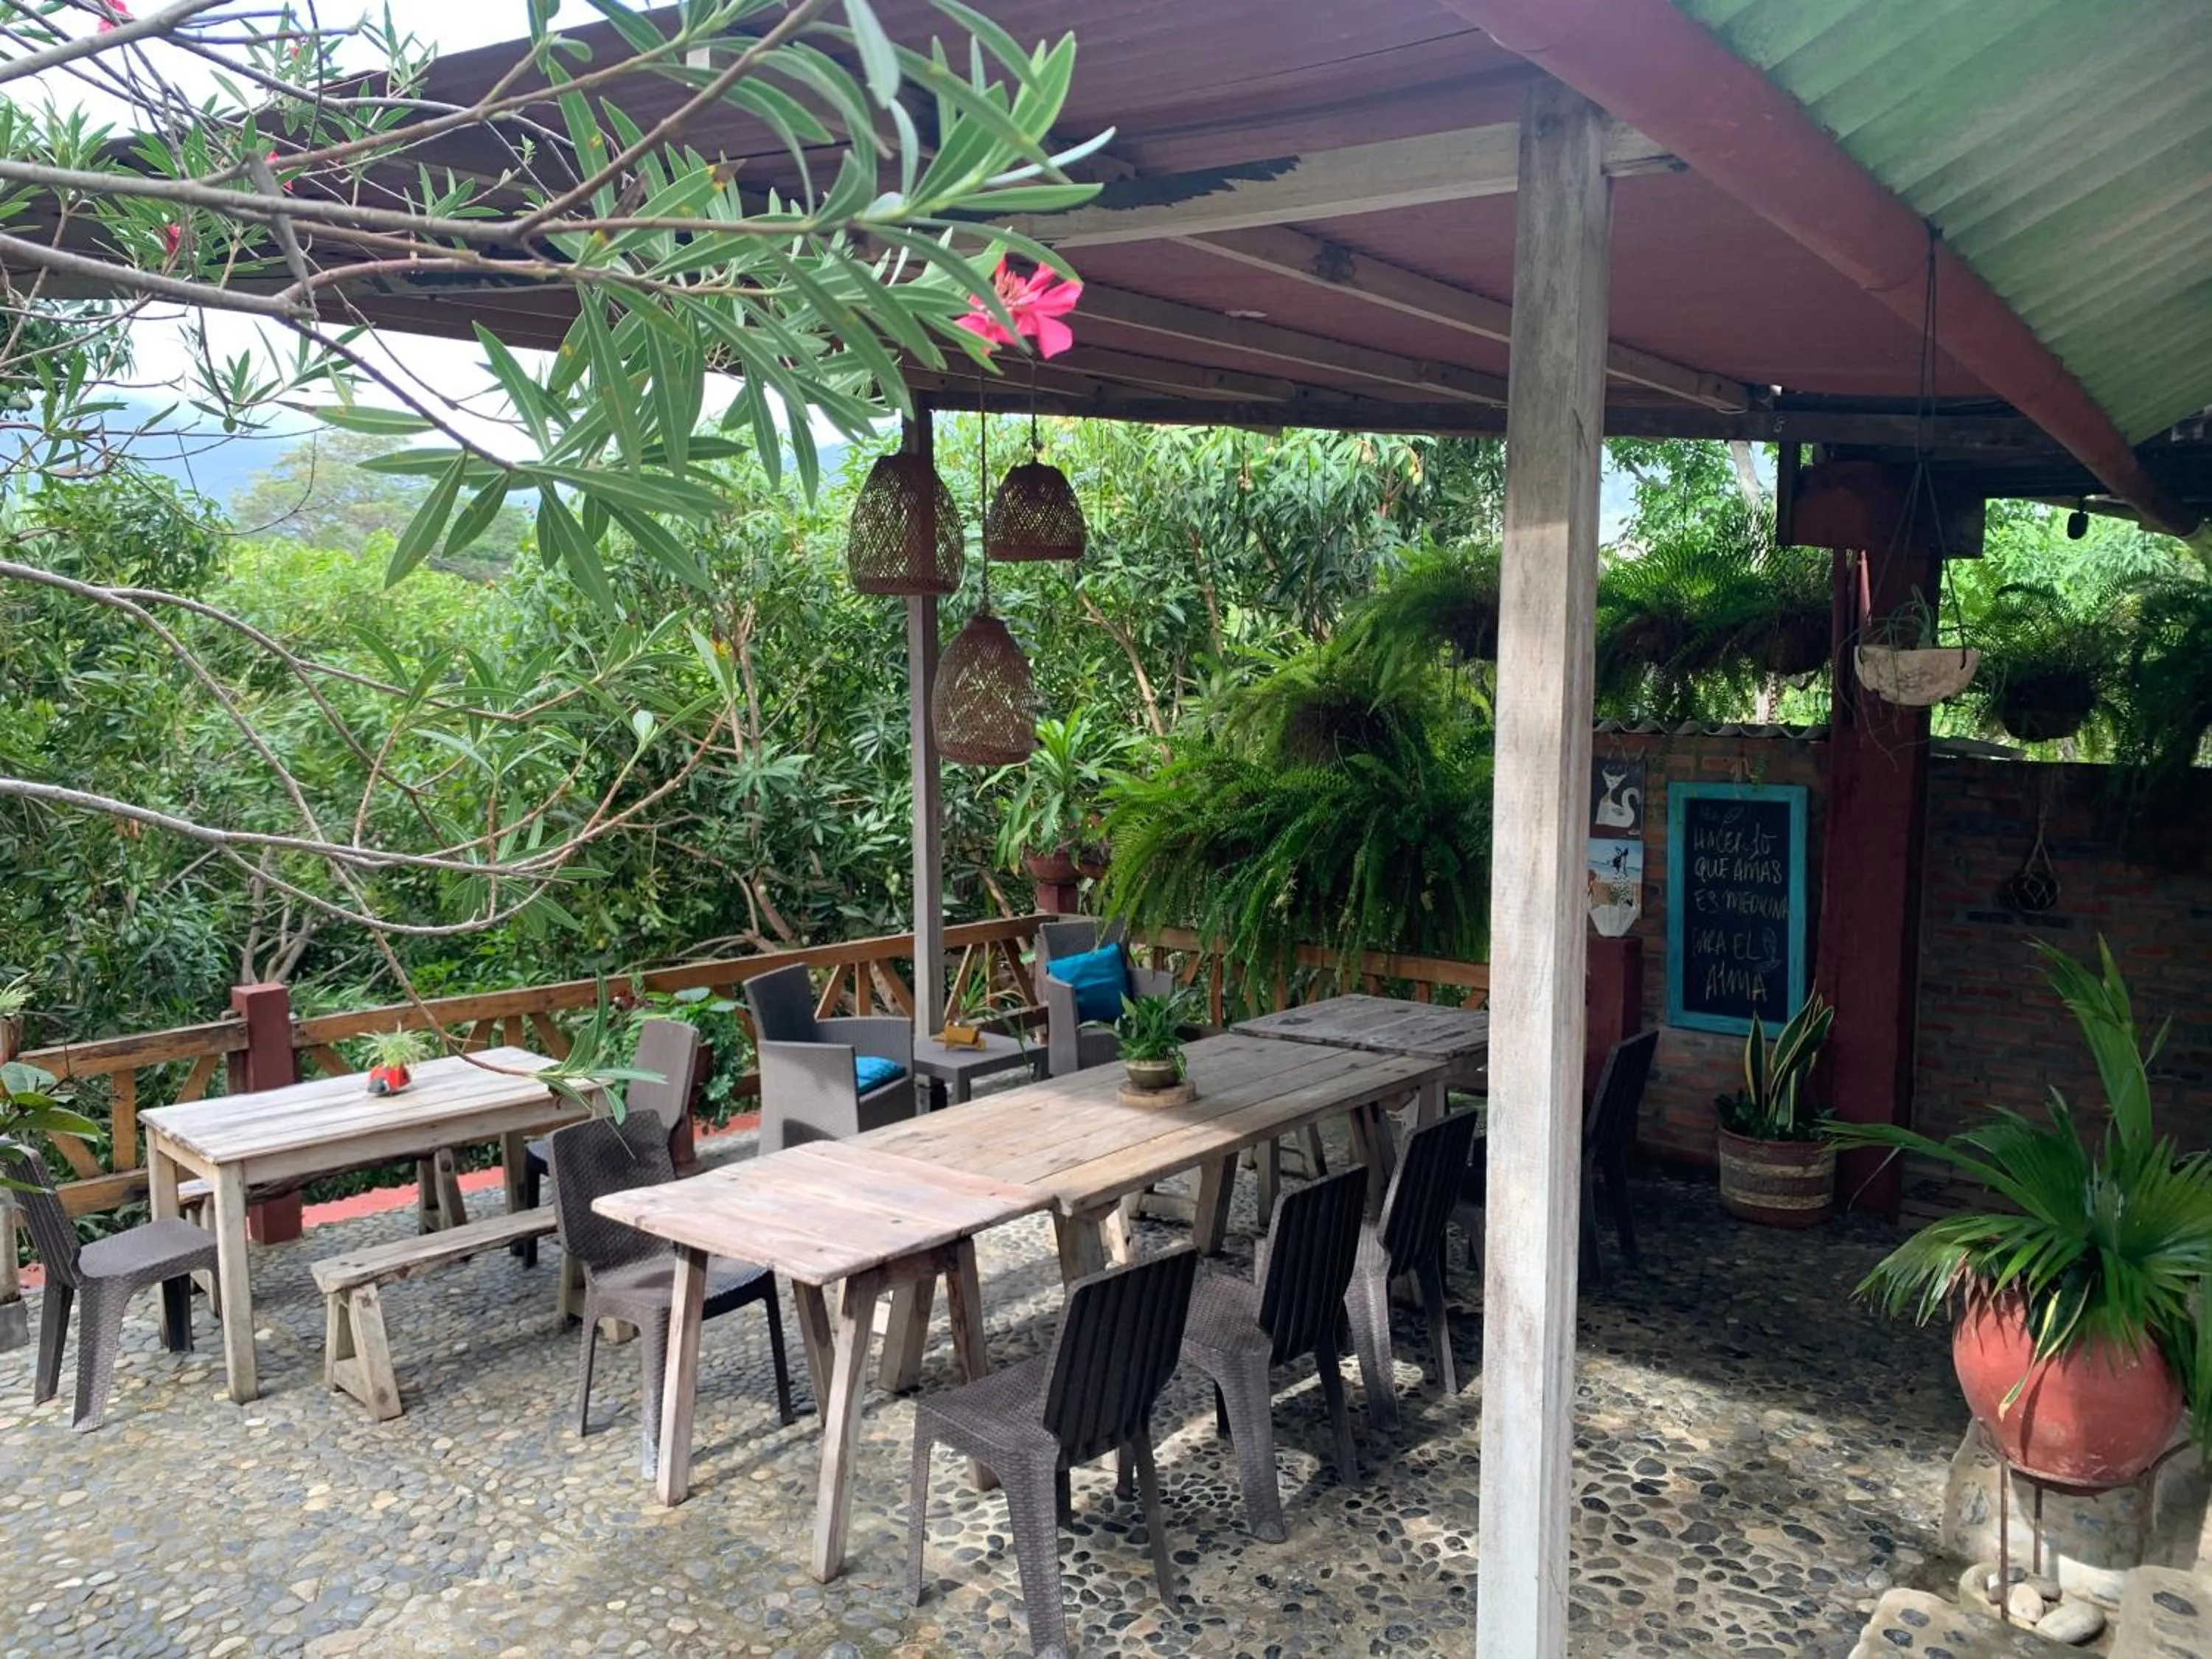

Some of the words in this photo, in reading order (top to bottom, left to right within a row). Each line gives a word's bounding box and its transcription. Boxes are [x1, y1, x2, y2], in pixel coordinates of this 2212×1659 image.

[1694, 856, 1730, 883] QUE
[1733, 859, 1782, 885] AMAS
[1694, 887, 1720, 914] ES
[1733, 931, 1761, 960] EL
